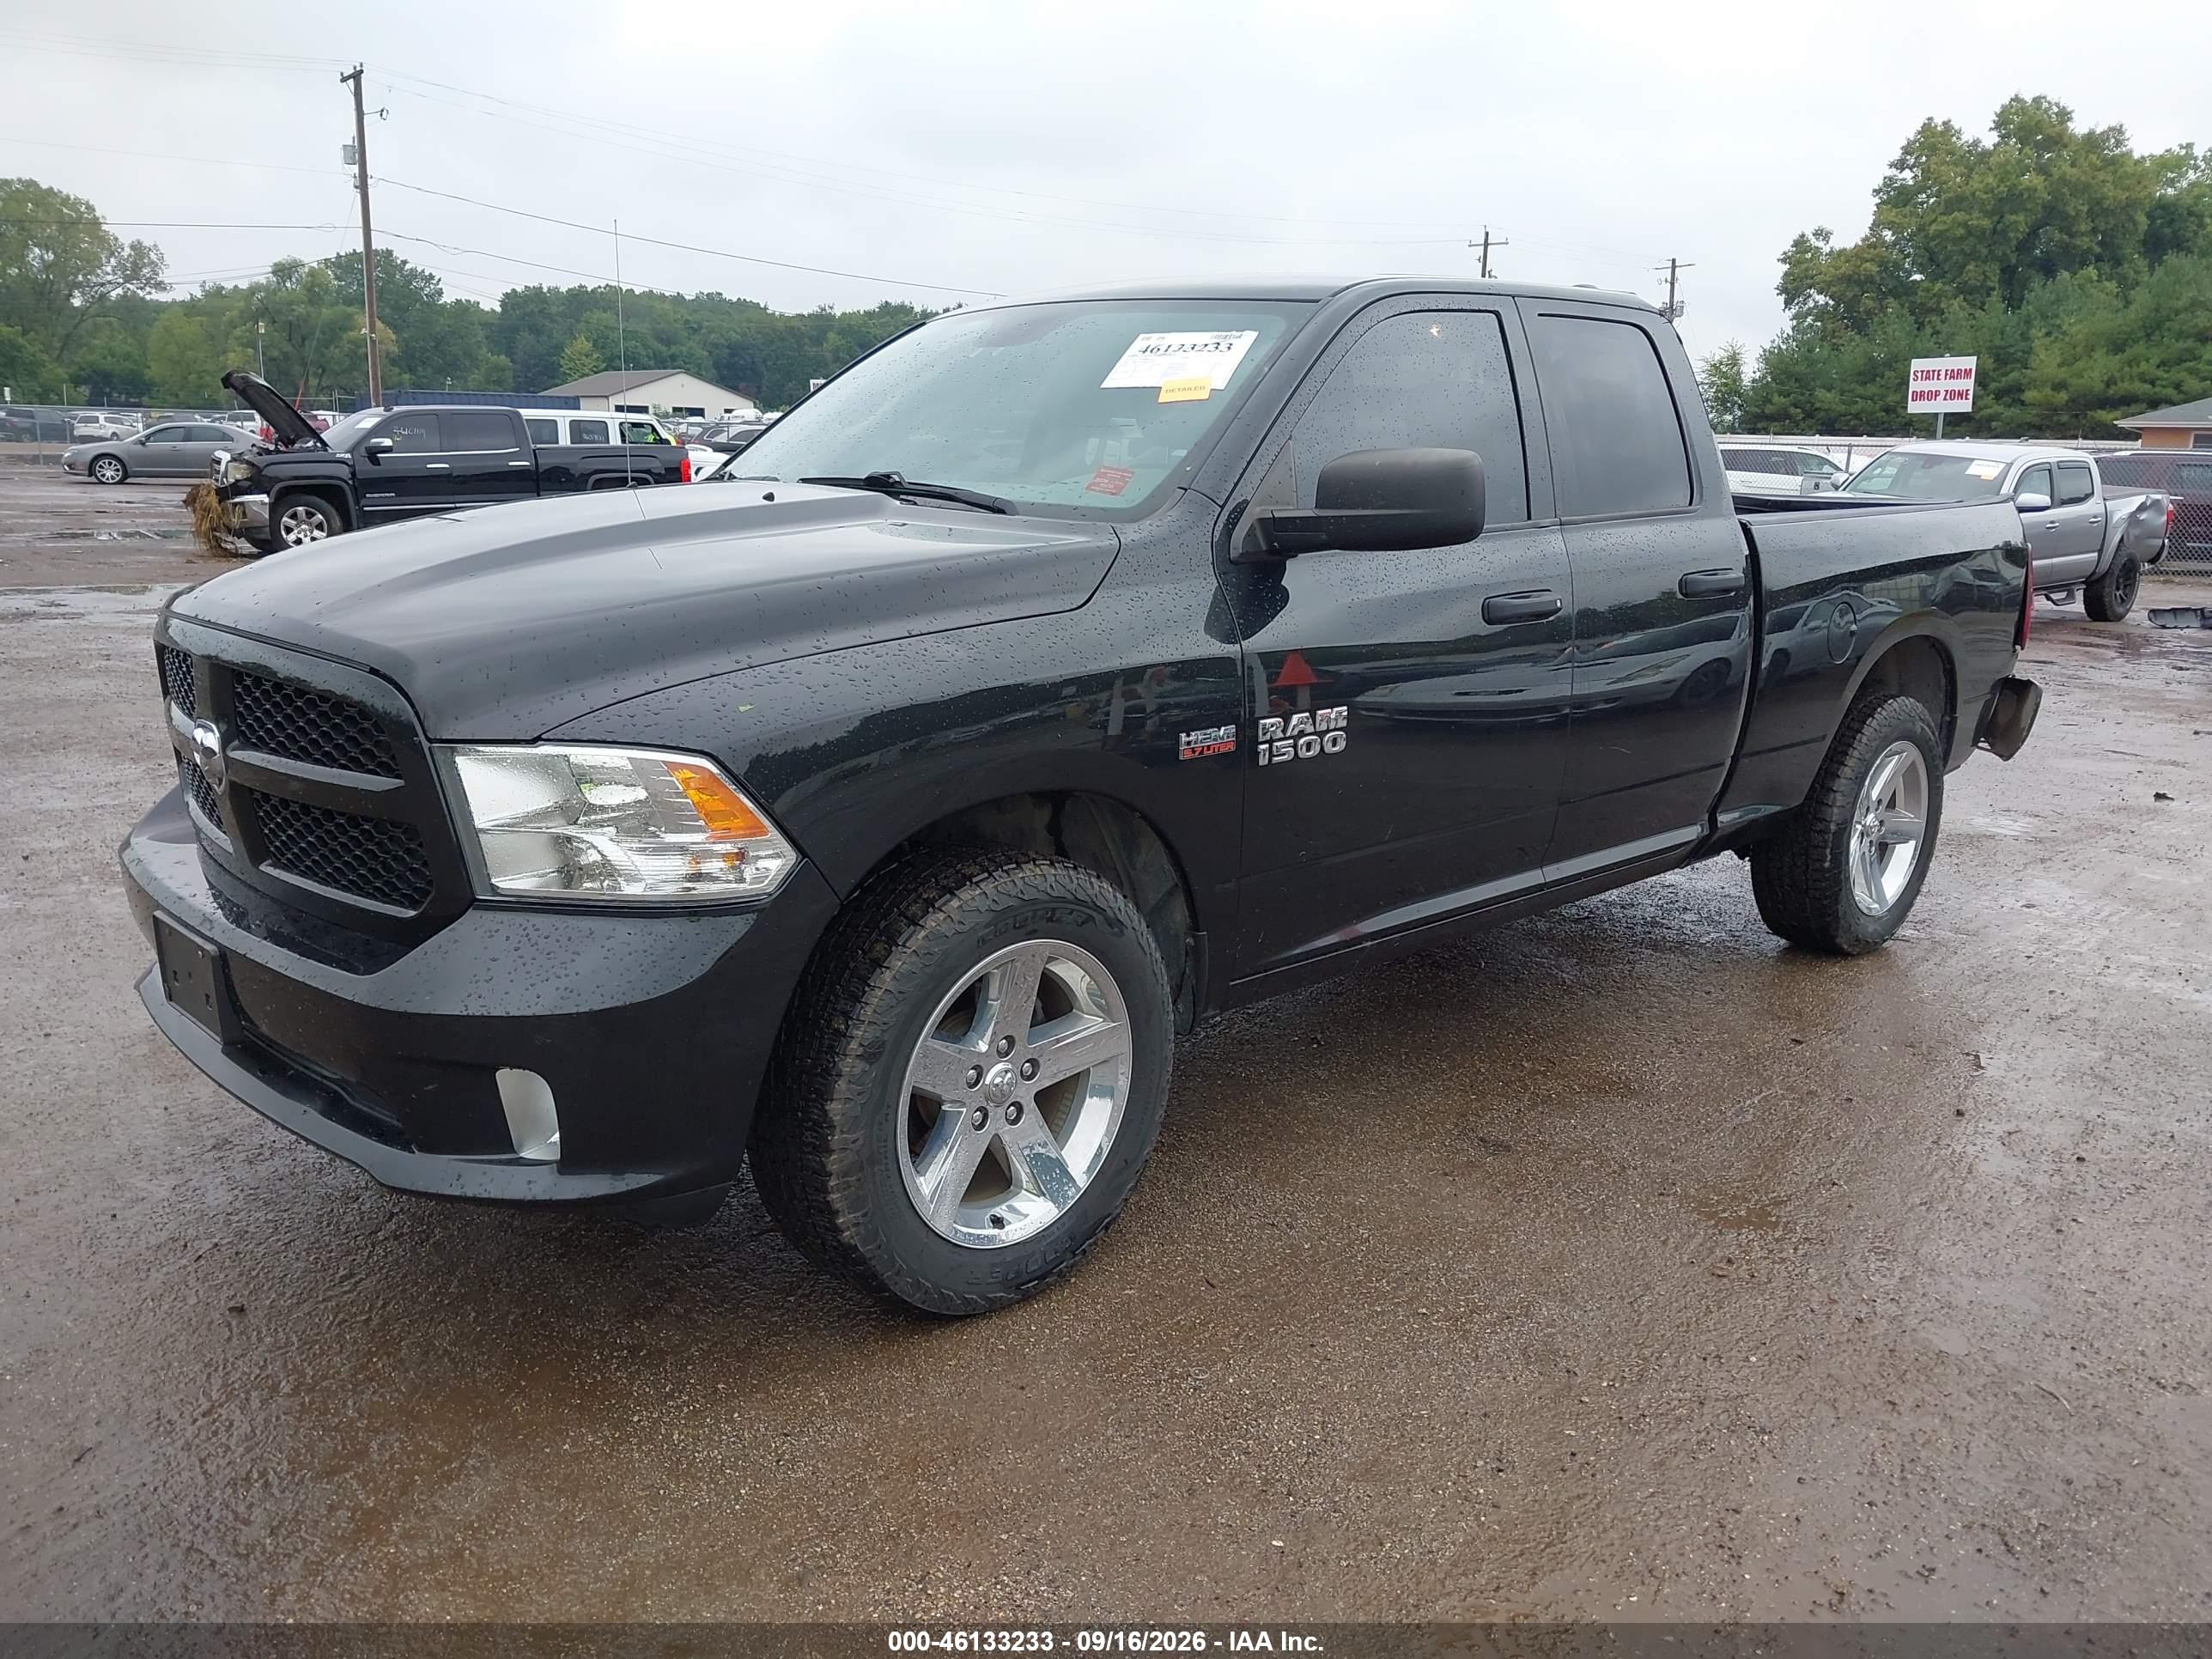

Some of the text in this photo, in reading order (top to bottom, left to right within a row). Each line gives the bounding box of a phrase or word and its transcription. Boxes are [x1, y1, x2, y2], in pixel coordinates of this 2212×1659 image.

[1139, 342, 1233, 354] 46133233
[1912, 368, 1972, 381] STATE FARM
[1911, 389, 1970, 402] DROP ZONE
[1257, 706, 1348, 742] RAM
[1179, 725, 1236, 749] HEMI
[1183, 741, 1234, 758] 5.7 LITER
[1257, 731, 1346, 767] 1500
